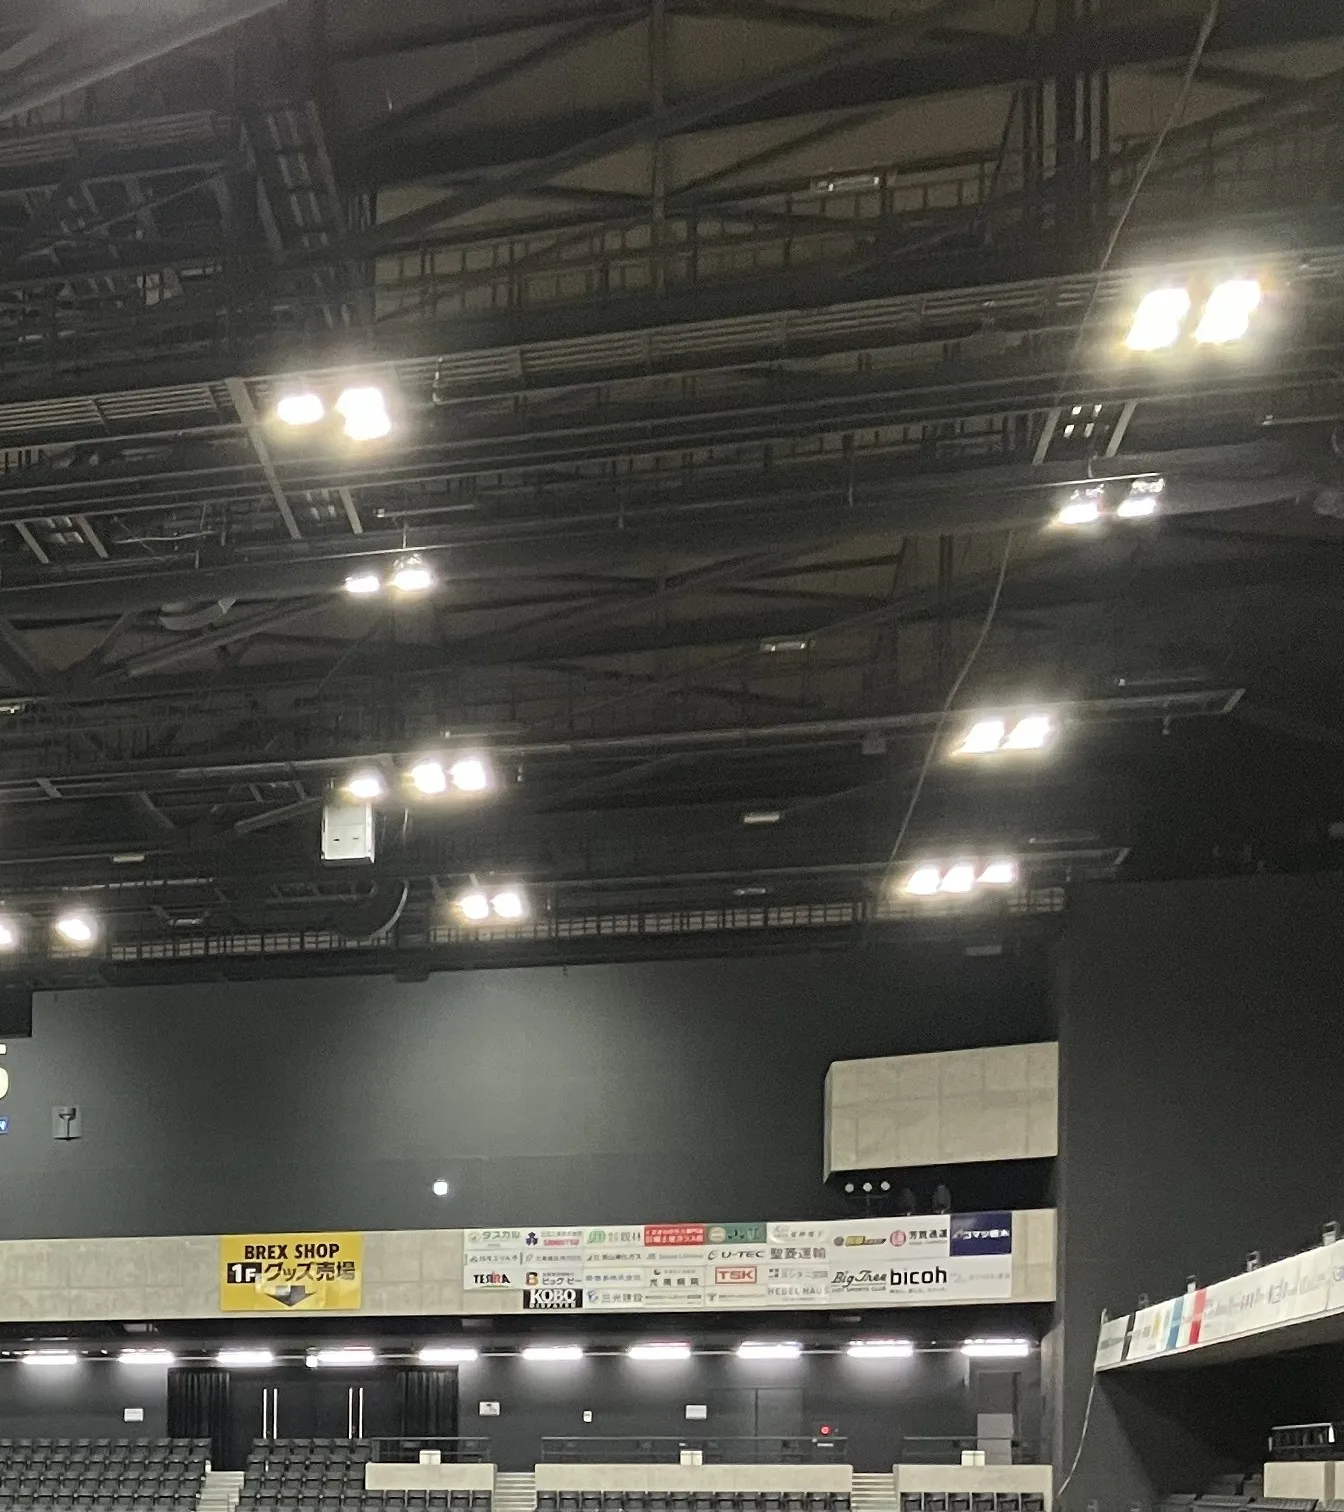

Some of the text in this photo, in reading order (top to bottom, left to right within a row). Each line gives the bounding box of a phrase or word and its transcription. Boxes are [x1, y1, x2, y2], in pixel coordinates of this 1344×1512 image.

[244, 1243, 340, 1260] BREX SHOP
[232, 1261, 356, 1282] 1F グッズ売場
[718, 1270, 754, 1280] TSK
[831, 1271, 854, 1288] Big
[855, 1269, 887, 1283] Tree
[890, 1266, 947, 1286] bicoh
